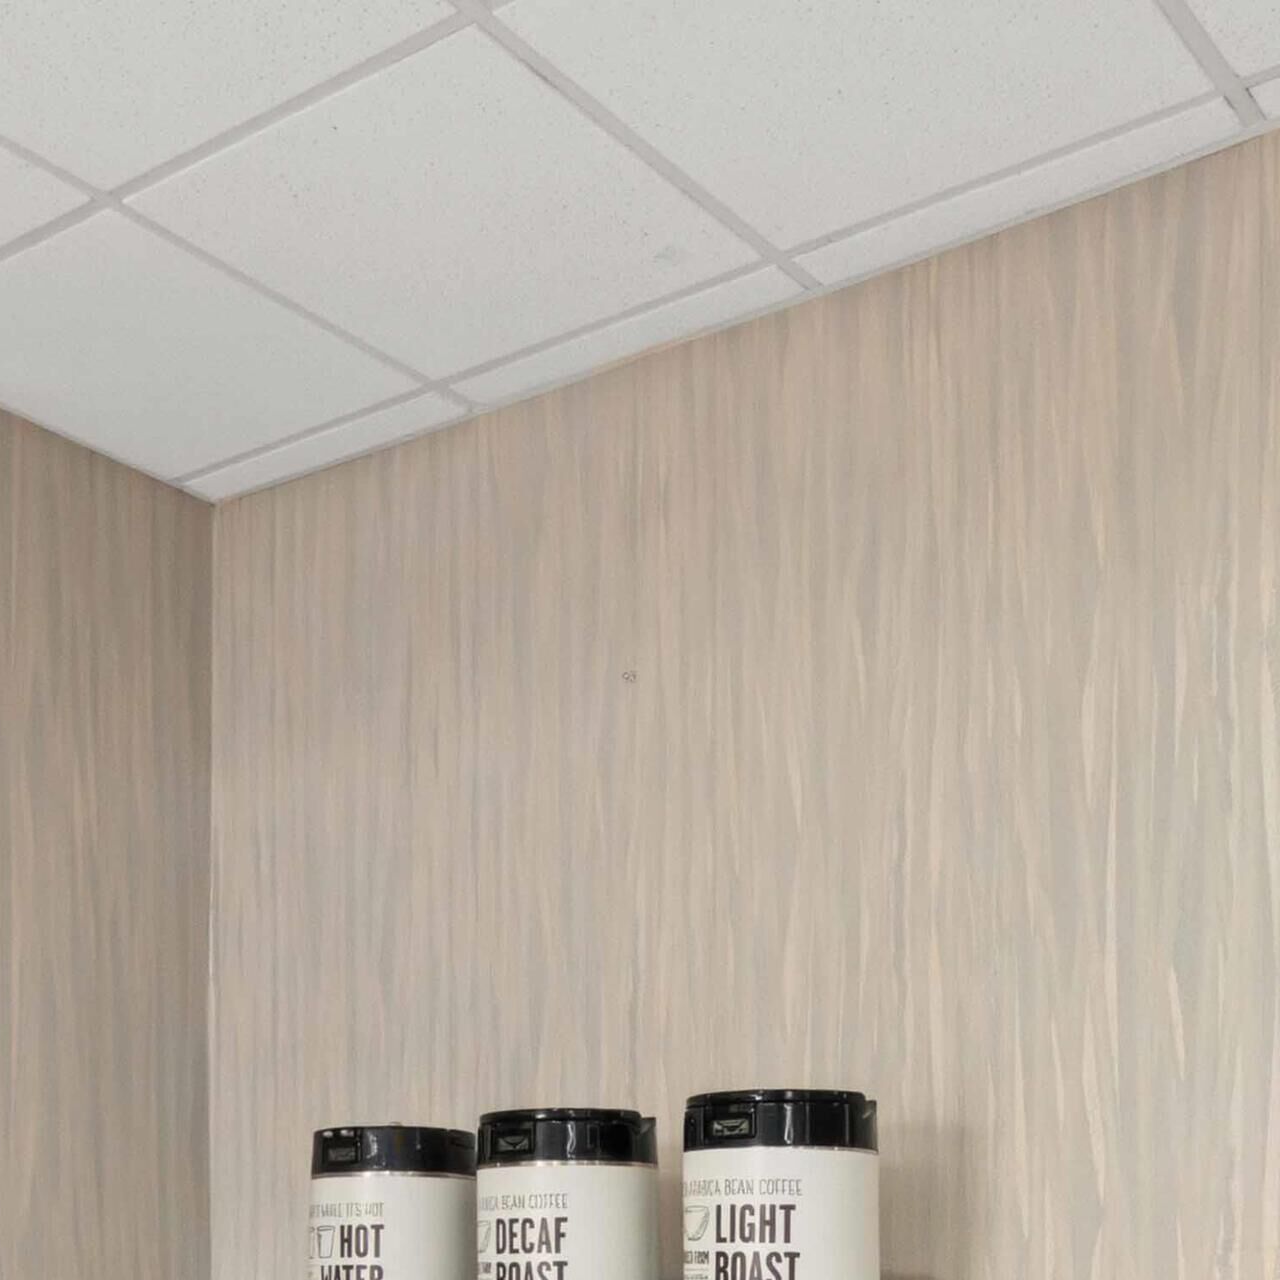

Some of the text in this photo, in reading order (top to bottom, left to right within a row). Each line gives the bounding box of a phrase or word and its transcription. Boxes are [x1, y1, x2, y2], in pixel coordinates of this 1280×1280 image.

[528, 1192, 568, 1210] COFFEE
[724, 1178, 754, 1196] BEAN
[759, 1178, 803, 1196] COFFEE
[340, 1223, 385, 1258] HOT
[496, 1216, 568, 1255] DECAF
[715, 1203, 796, 1244] LIGHT
